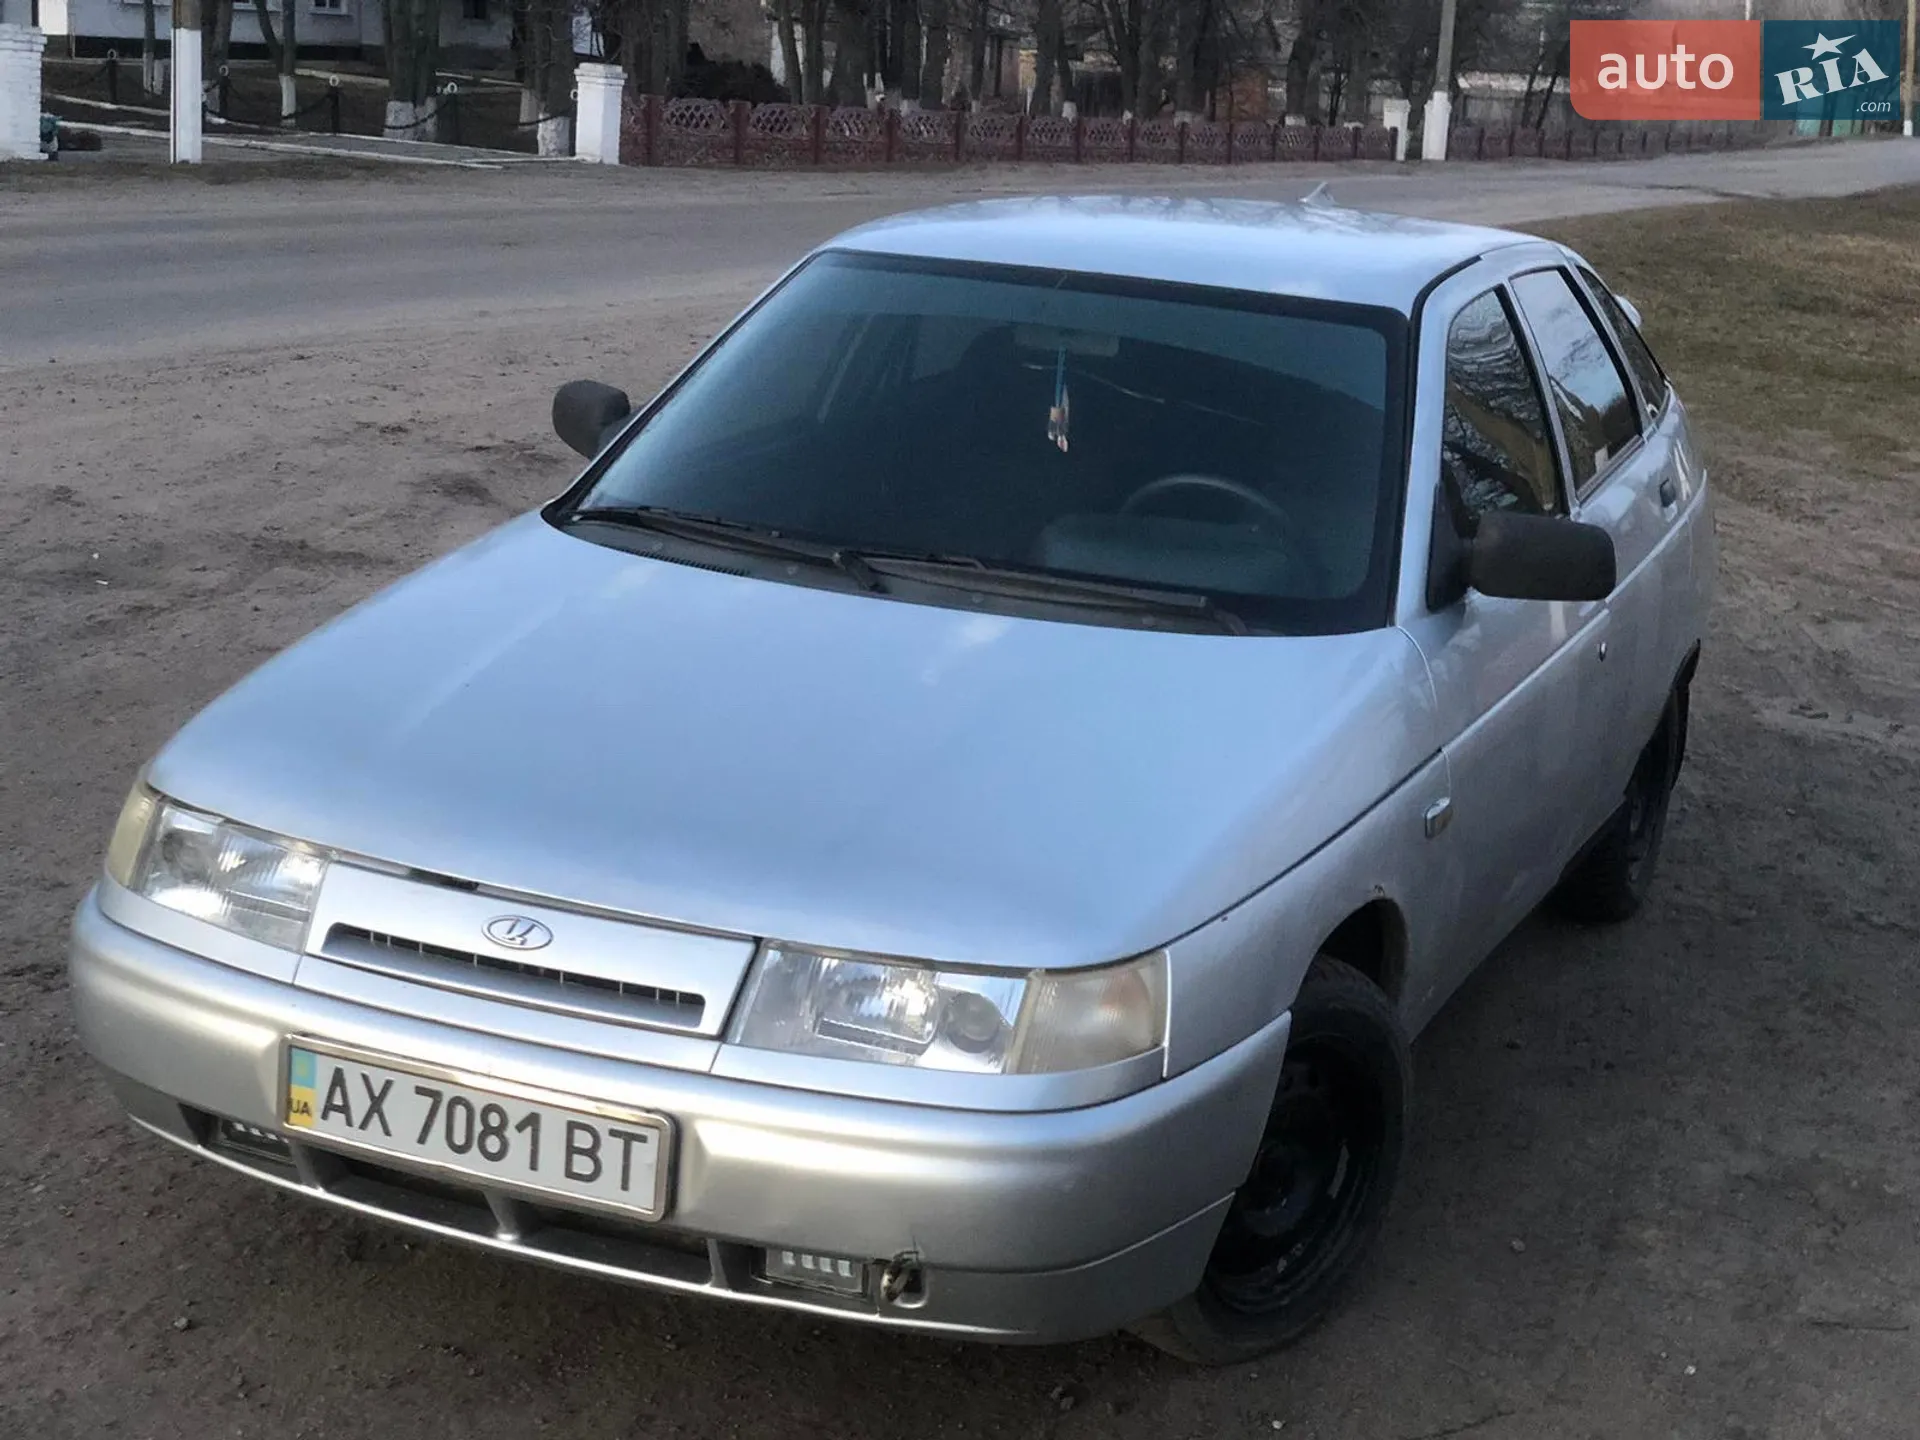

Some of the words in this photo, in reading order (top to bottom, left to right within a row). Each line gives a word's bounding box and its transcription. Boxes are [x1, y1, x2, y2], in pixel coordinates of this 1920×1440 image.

[287, 1098, 312, 1117] UA
[321, 1067, 393, 1137] AX
[414, 1085, 541, 1171] 7081
[564, 1120, 649, 1192] BT
